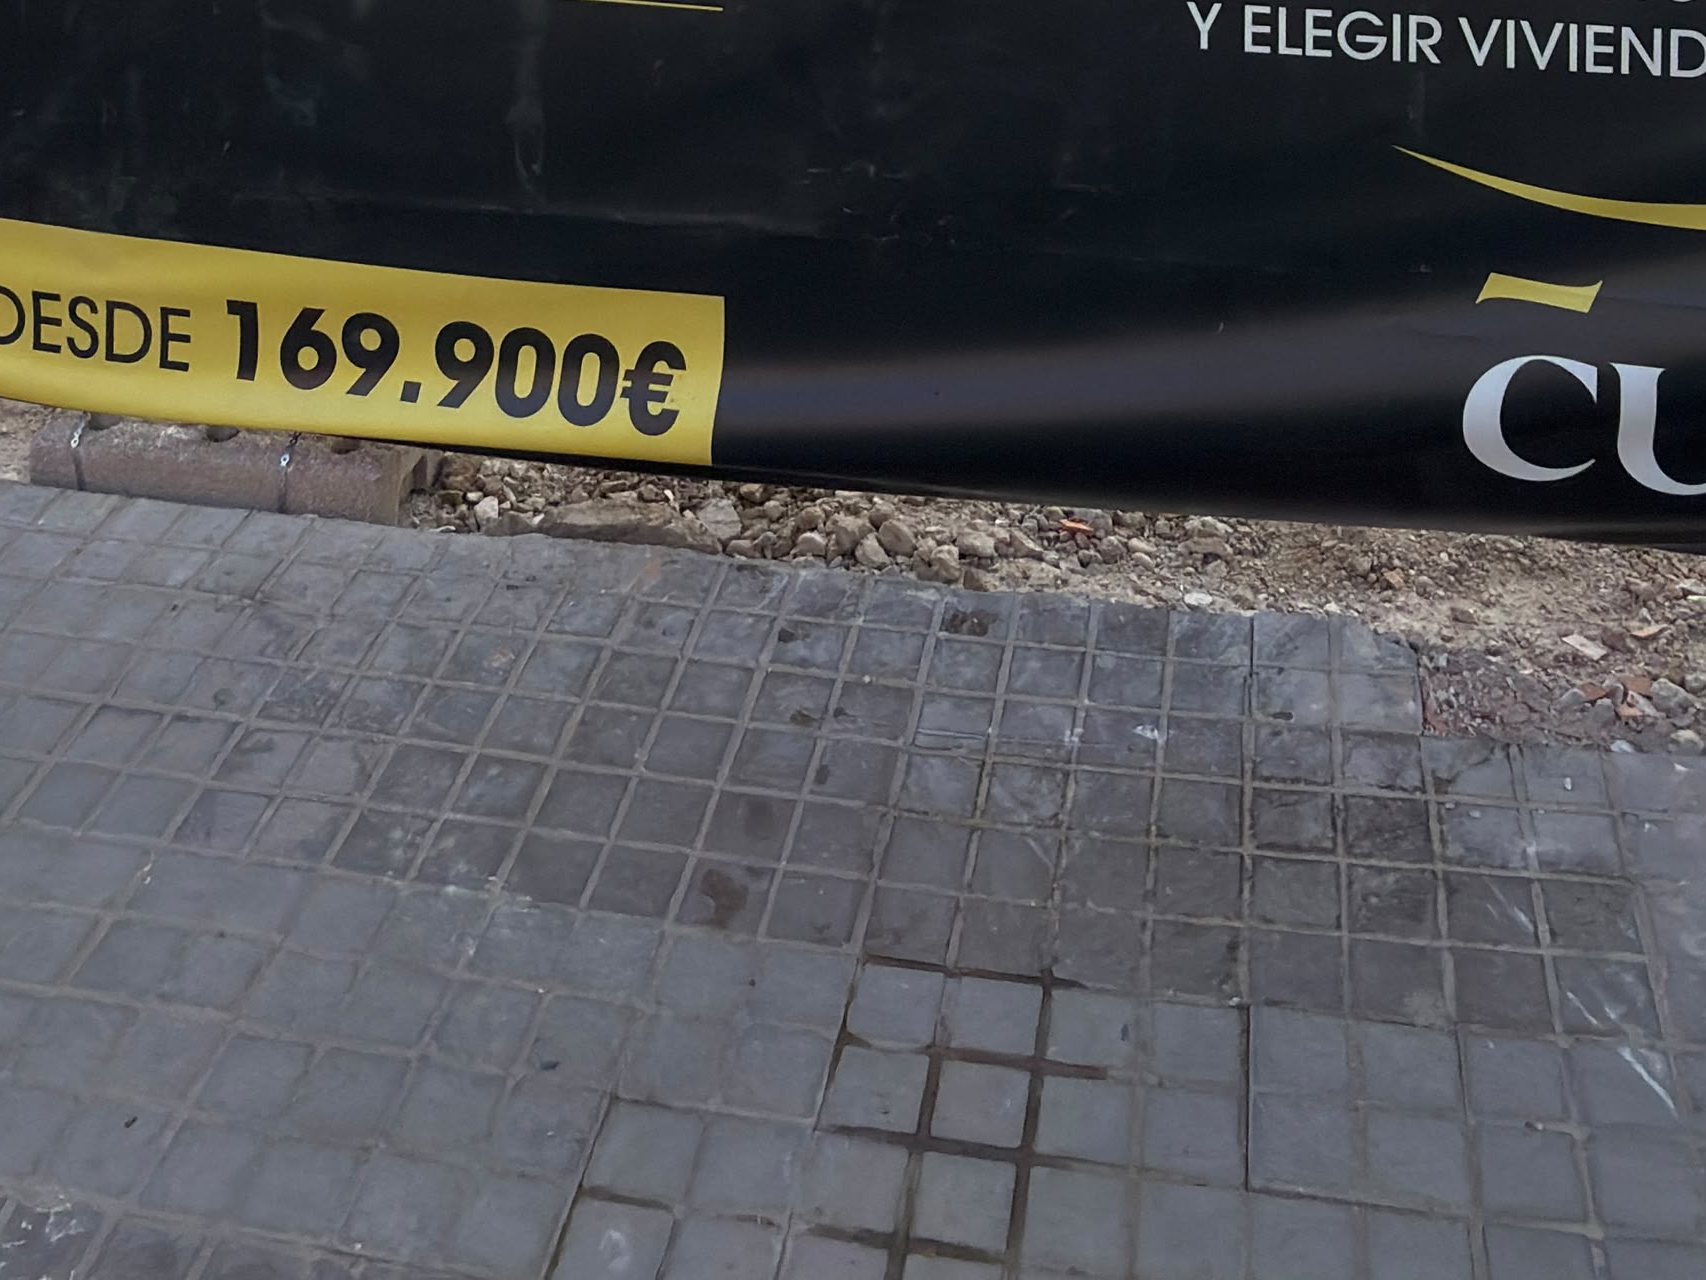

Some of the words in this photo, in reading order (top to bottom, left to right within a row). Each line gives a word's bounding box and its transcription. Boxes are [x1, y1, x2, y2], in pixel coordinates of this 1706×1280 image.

[1187, 2, 1221, 49] Y
[1245, 5, 1441, 63] ELEGIR
[225, 298, 688, 437] 169.900€
